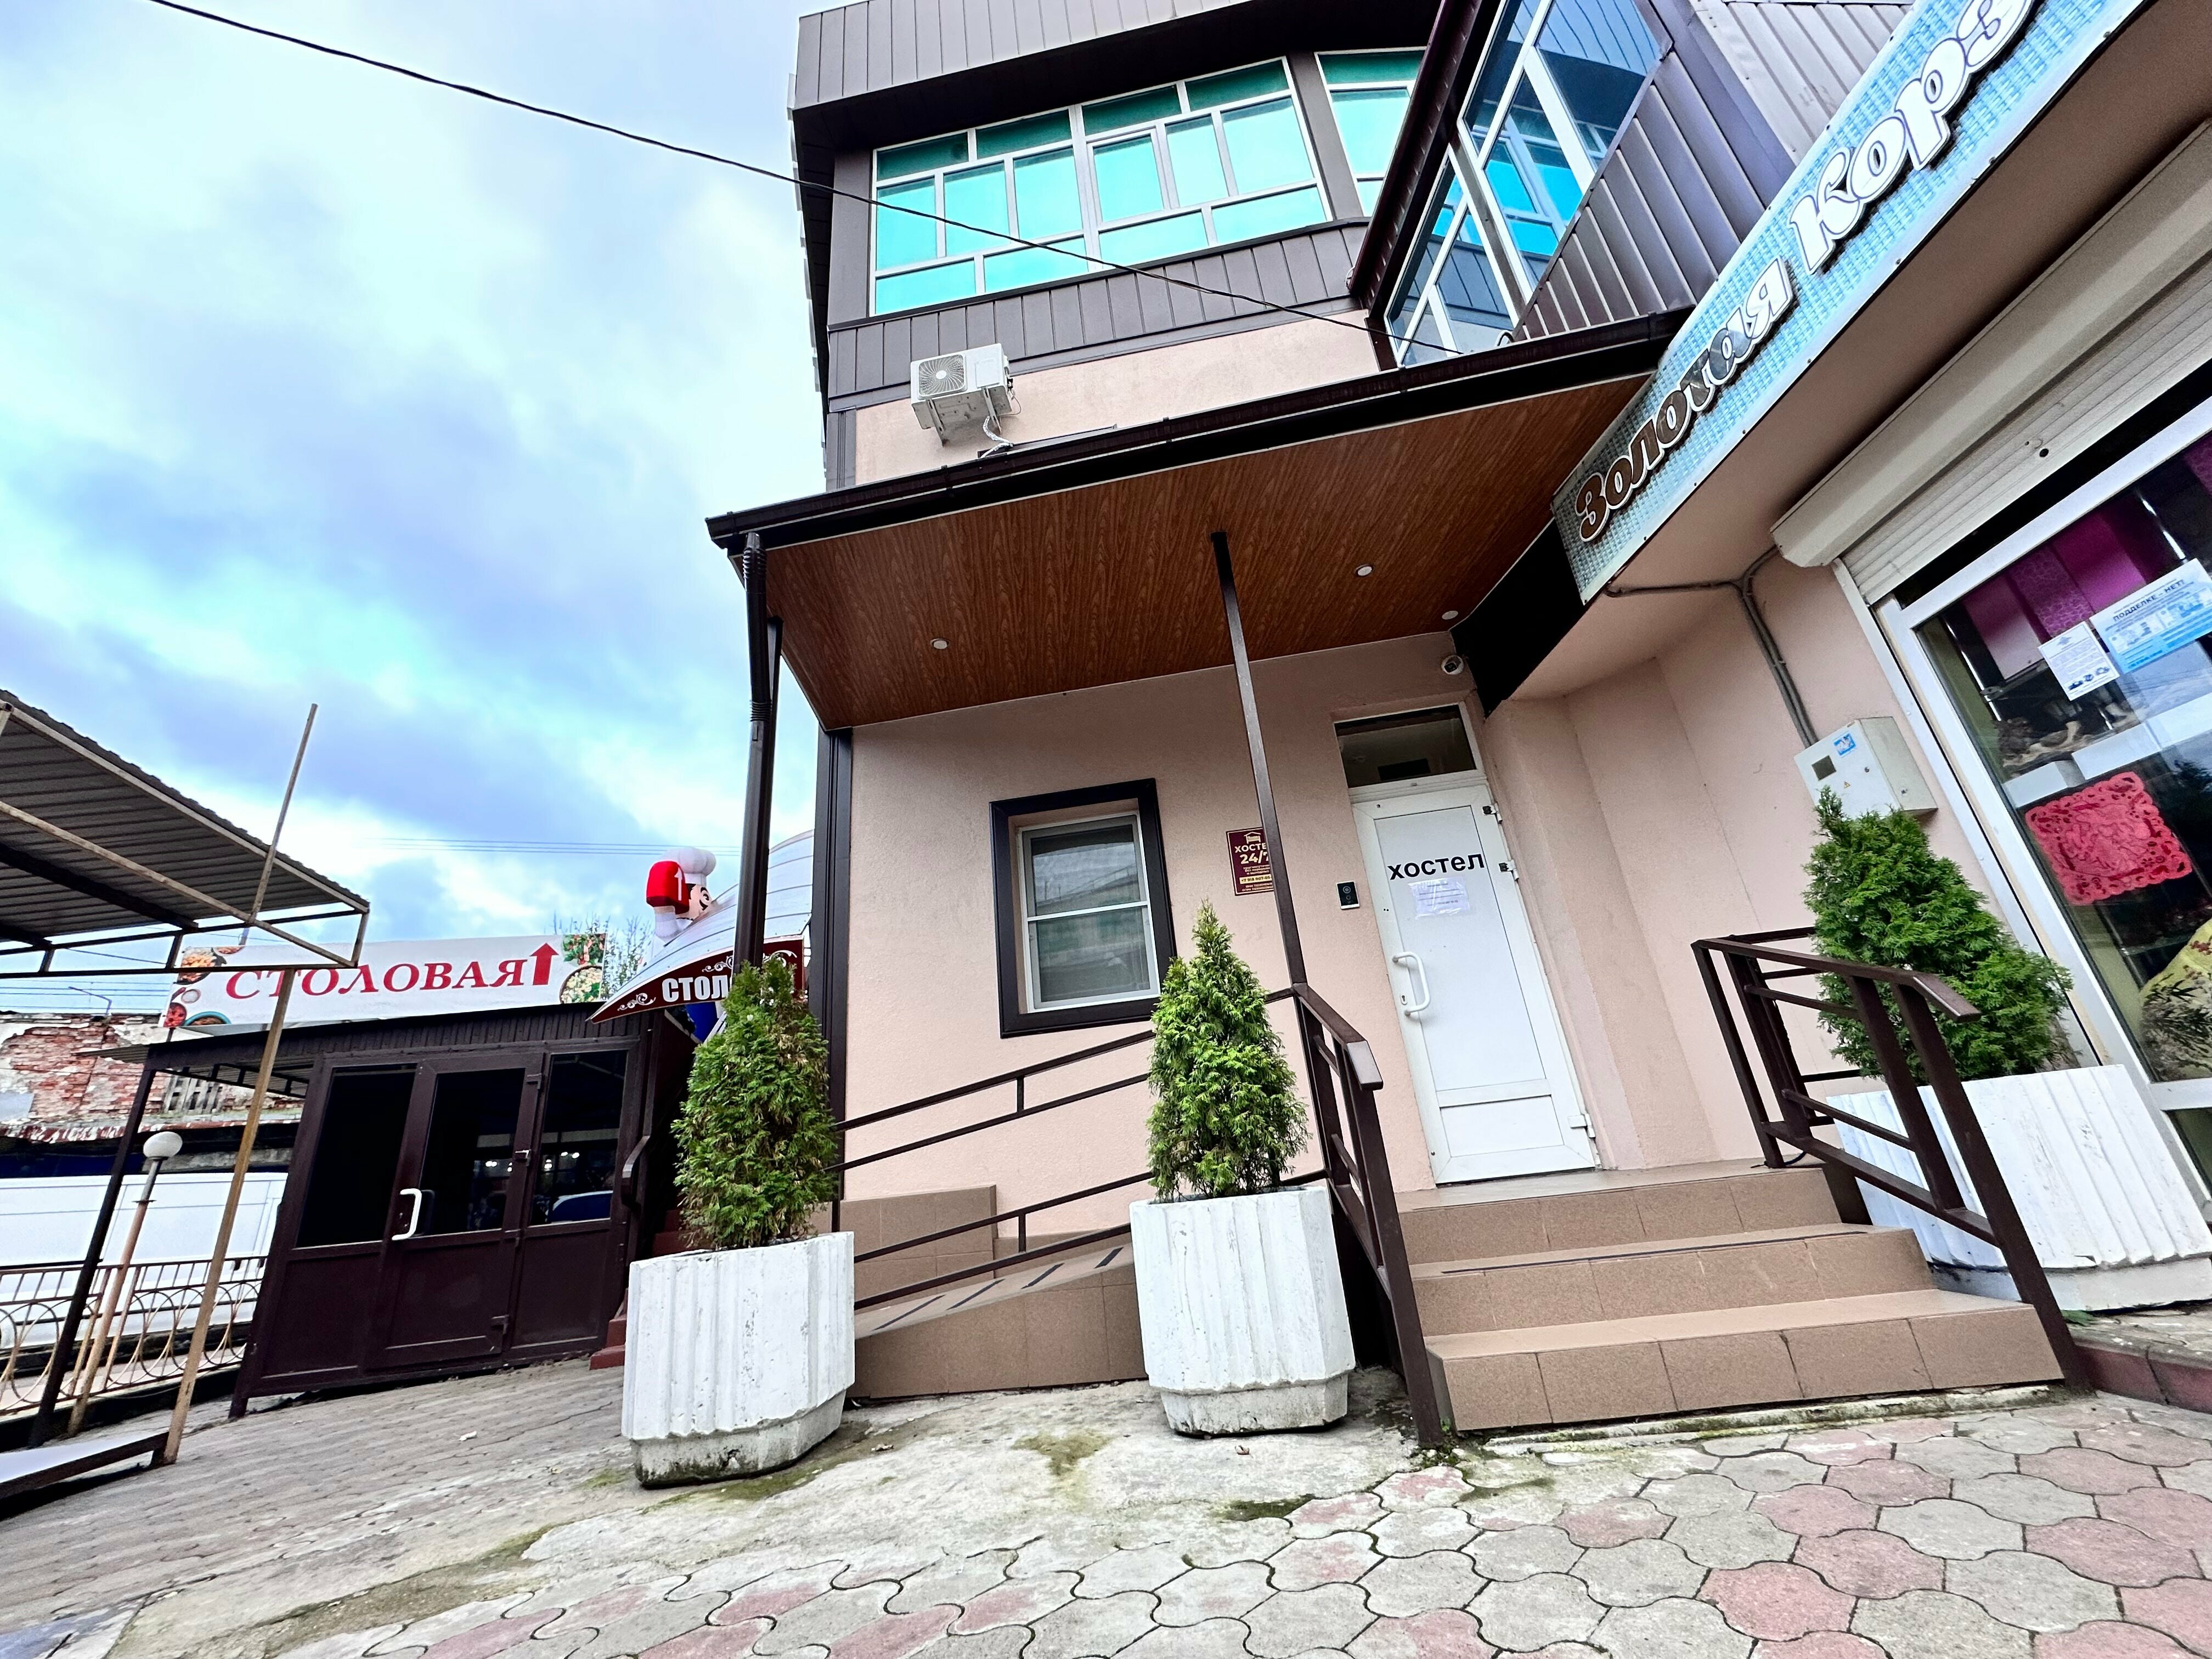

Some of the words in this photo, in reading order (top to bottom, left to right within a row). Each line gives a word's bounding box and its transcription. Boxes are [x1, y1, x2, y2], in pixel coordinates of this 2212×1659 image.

[1575, 256, 1795, 542] Золотая
[2113, 594, 2157, 622] ПОДДЕЛКЕ
[1234, 843, 1267, 853] ХОСТЕ
[1387, 853, 1485, 881] хостел
[226, 958, 528, 1000] СТОЛОВАЯ
[662, 974, 731, 1002] СТОЛ
